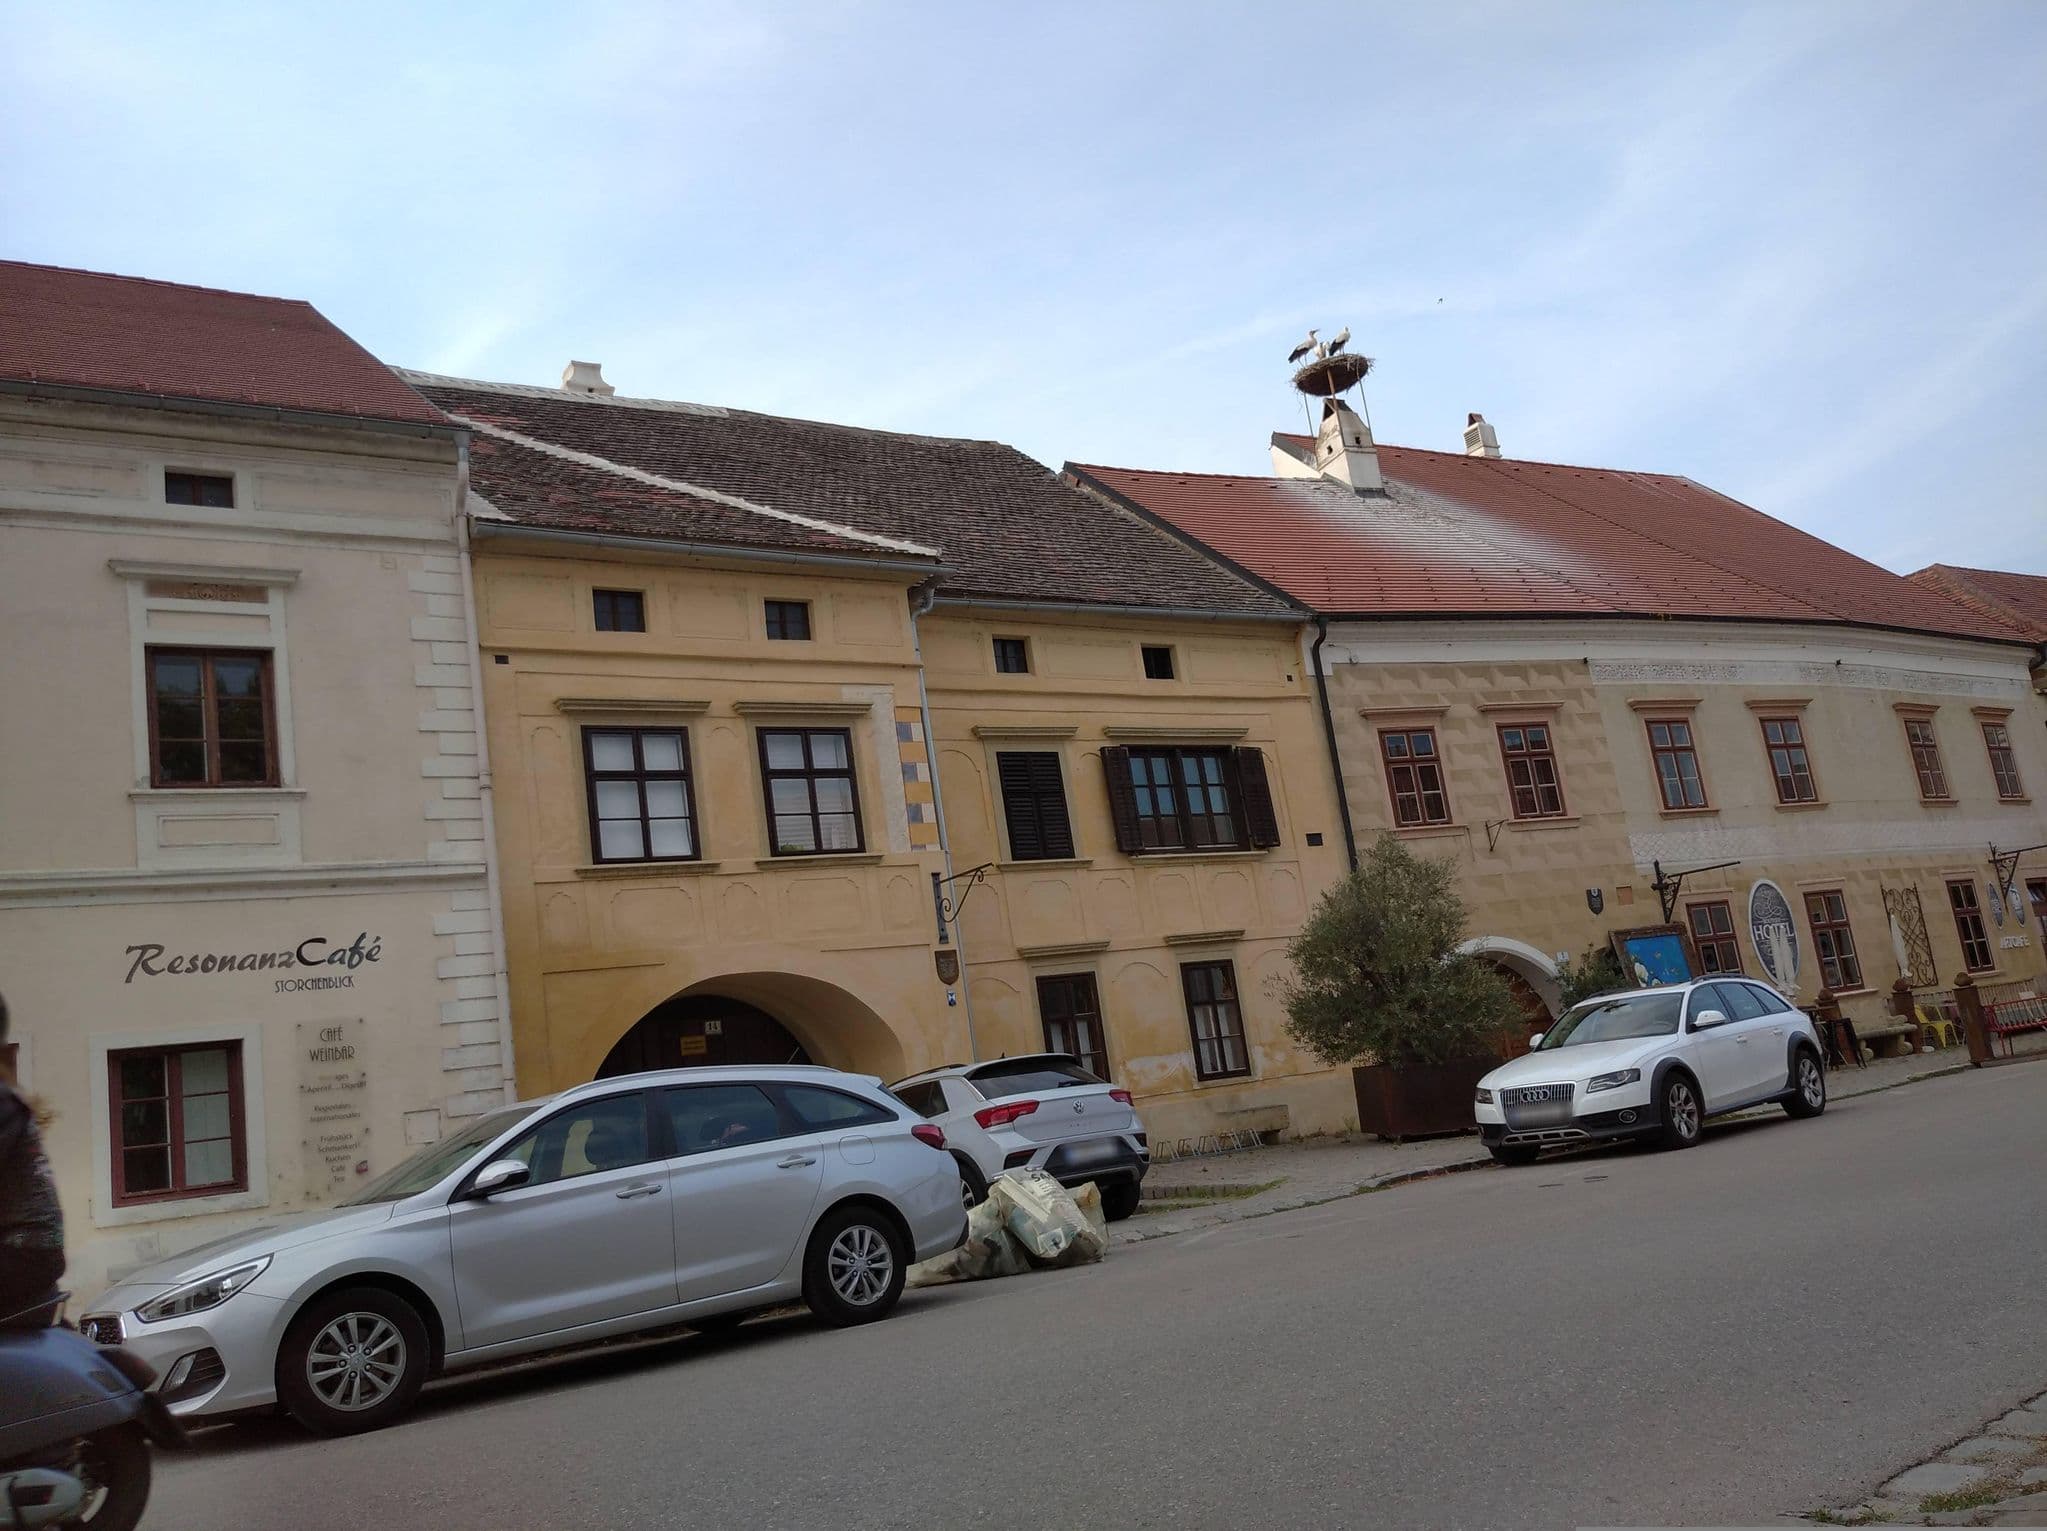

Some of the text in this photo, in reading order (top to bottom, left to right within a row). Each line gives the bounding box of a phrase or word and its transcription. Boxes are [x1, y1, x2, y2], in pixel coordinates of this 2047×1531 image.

[1753, 922, 1795, 941] HOTL
[125, 932, 383, 983] ResonanzCafé
[274, 976, 354, 993] STORCHENBLICK
[320, 1026, 343, 1041] CAFÉ
[309, 1045, 355, 1062] WEINBAR
